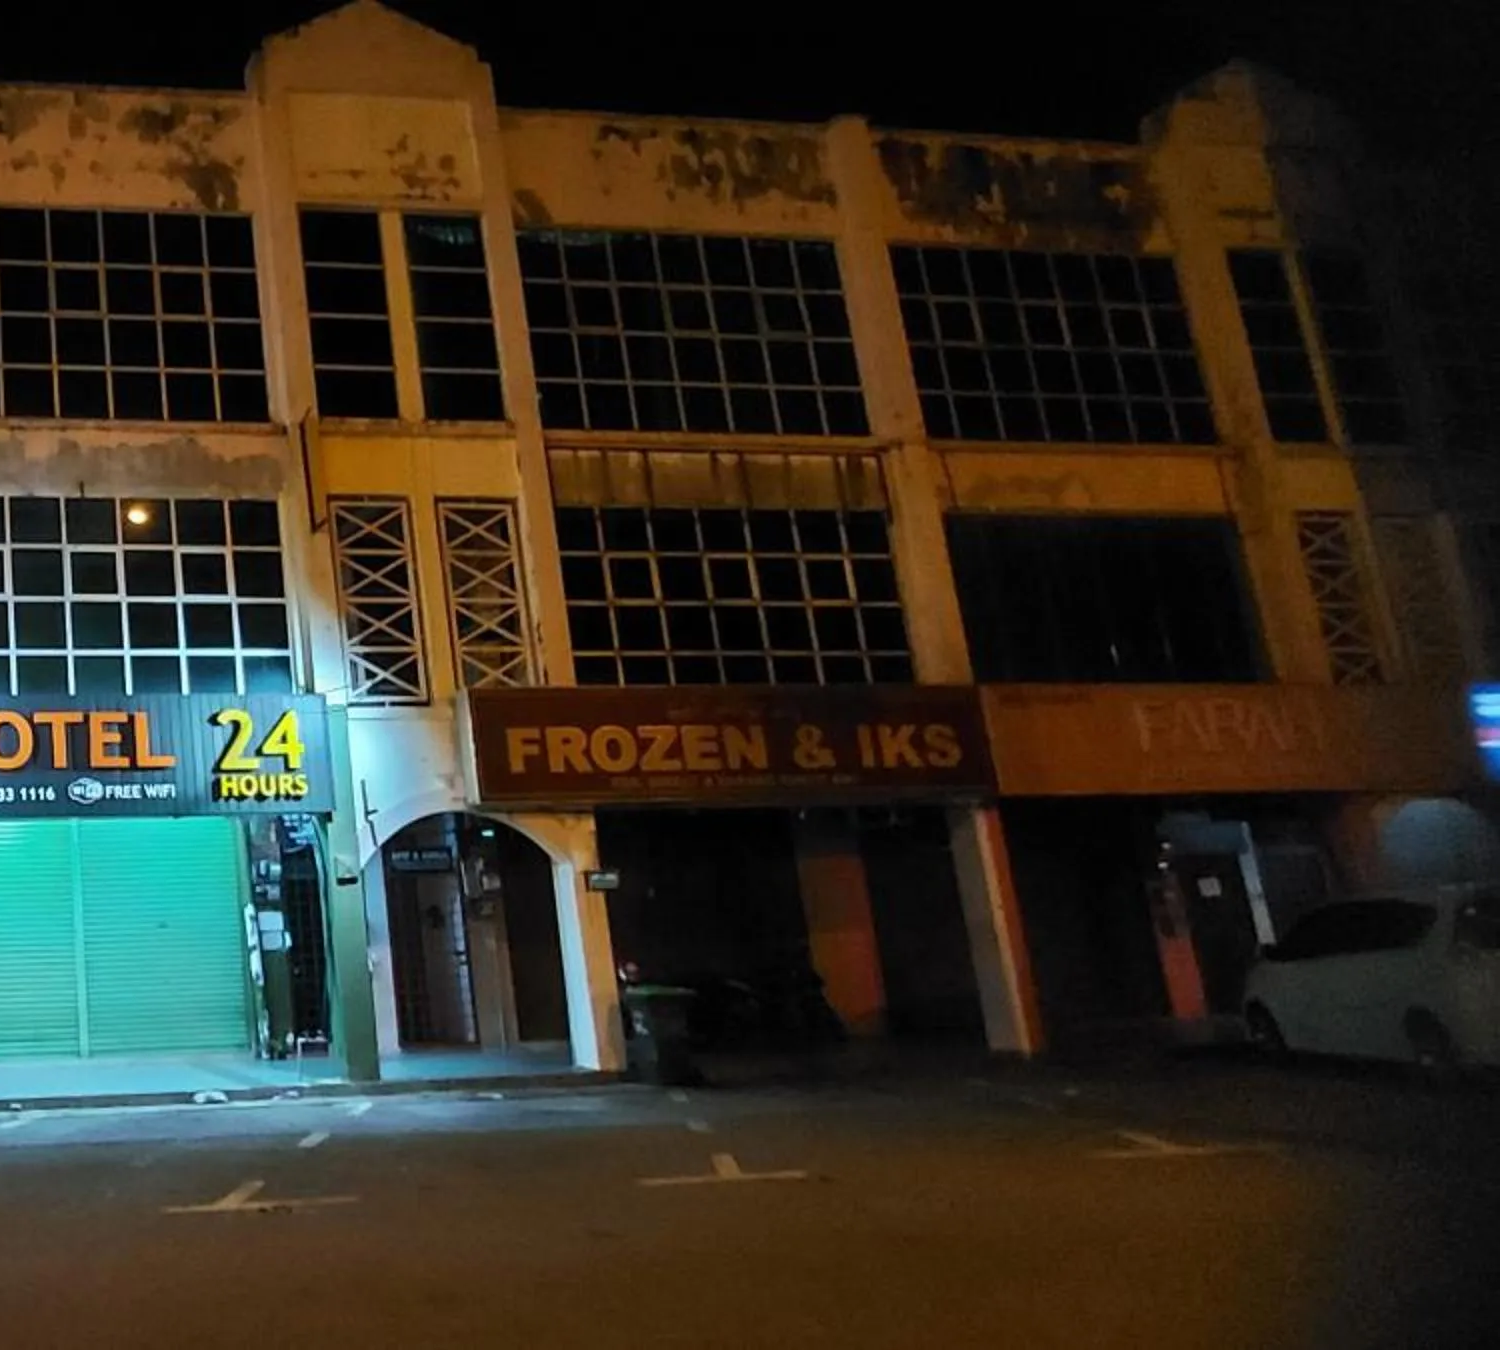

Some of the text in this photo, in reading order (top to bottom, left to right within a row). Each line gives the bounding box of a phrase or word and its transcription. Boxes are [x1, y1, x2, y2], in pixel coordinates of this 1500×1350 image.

[213, 707, 306, 773] 24
[505, 723, 964, 774] FROZEN & IKS
[19, 786, 56, 801] 1116
[105, 783, 143, 800] FREE
[220, 773, 309, 798] HOURS
